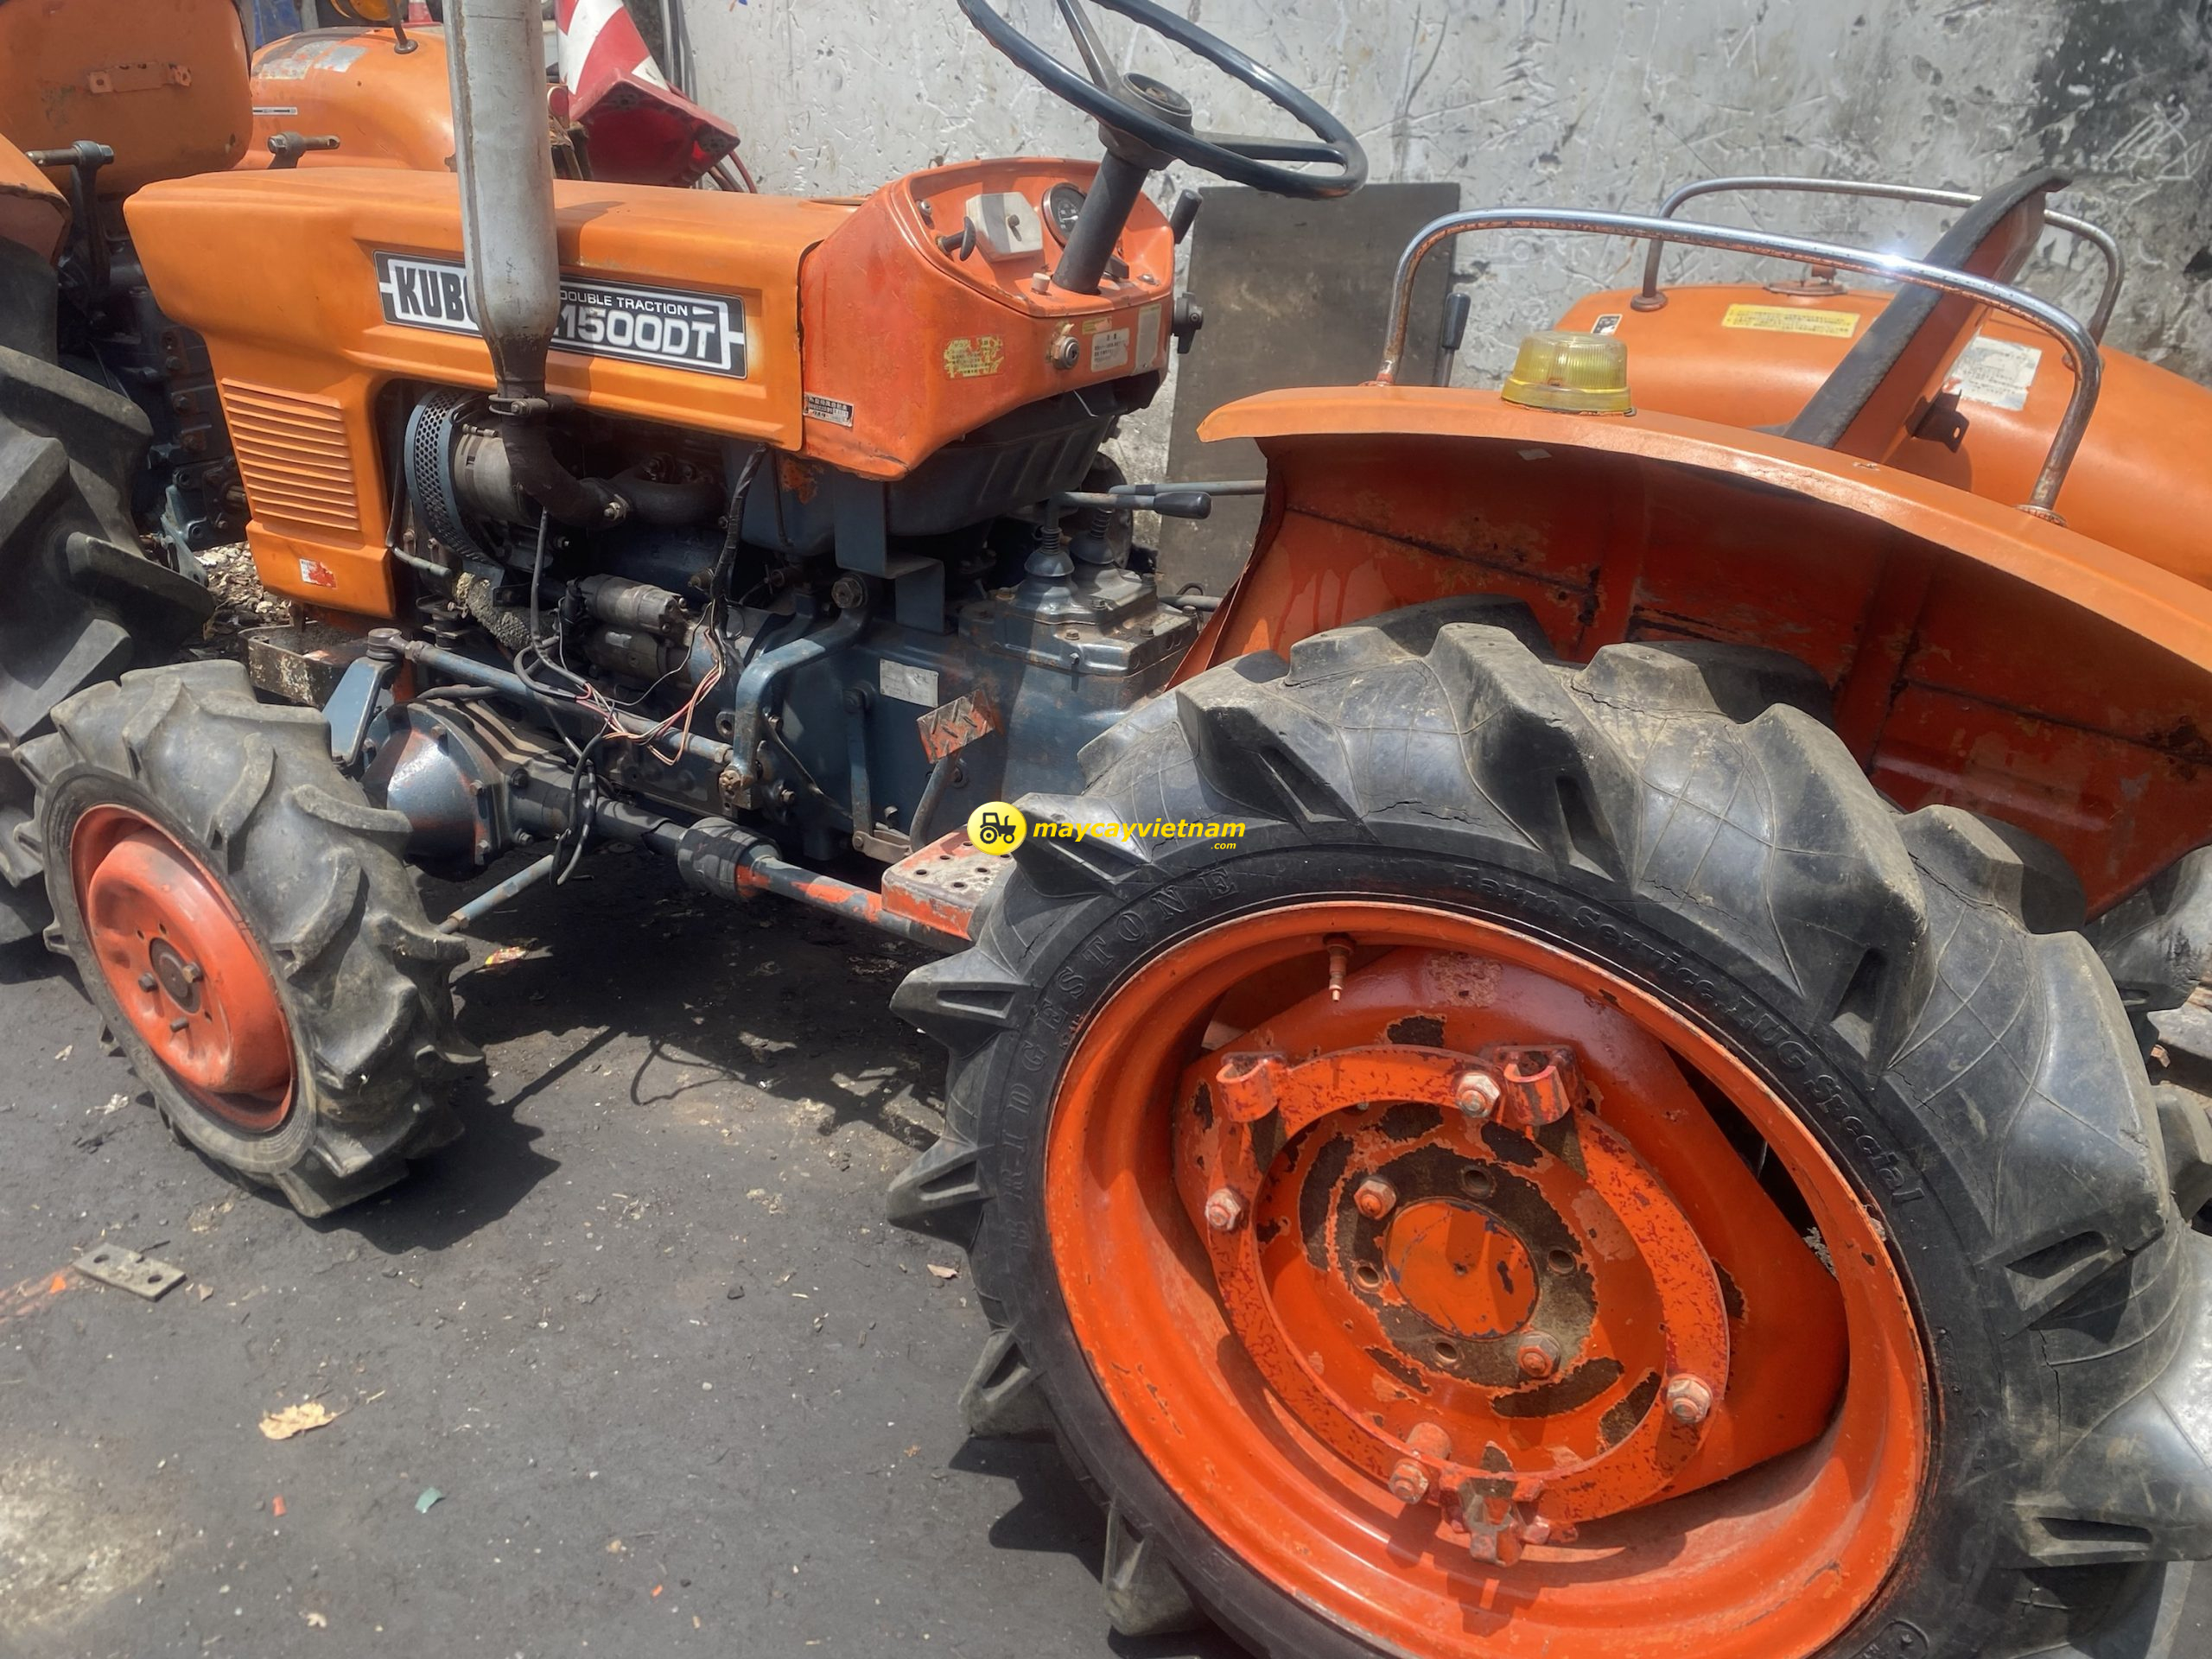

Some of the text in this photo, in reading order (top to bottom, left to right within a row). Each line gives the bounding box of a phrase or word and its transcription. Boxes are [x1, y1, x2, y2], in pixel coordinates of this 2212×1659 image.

[394, 265, 478, 325] KUB
[616, 296, 689, 317] TRACTION
[553, 304, 716, 359] 1500DT
[1000, 865, 1239, 1250] BRIDGESTONE
[1453, 863, 1926, 1206] Farm Service LUG Special
